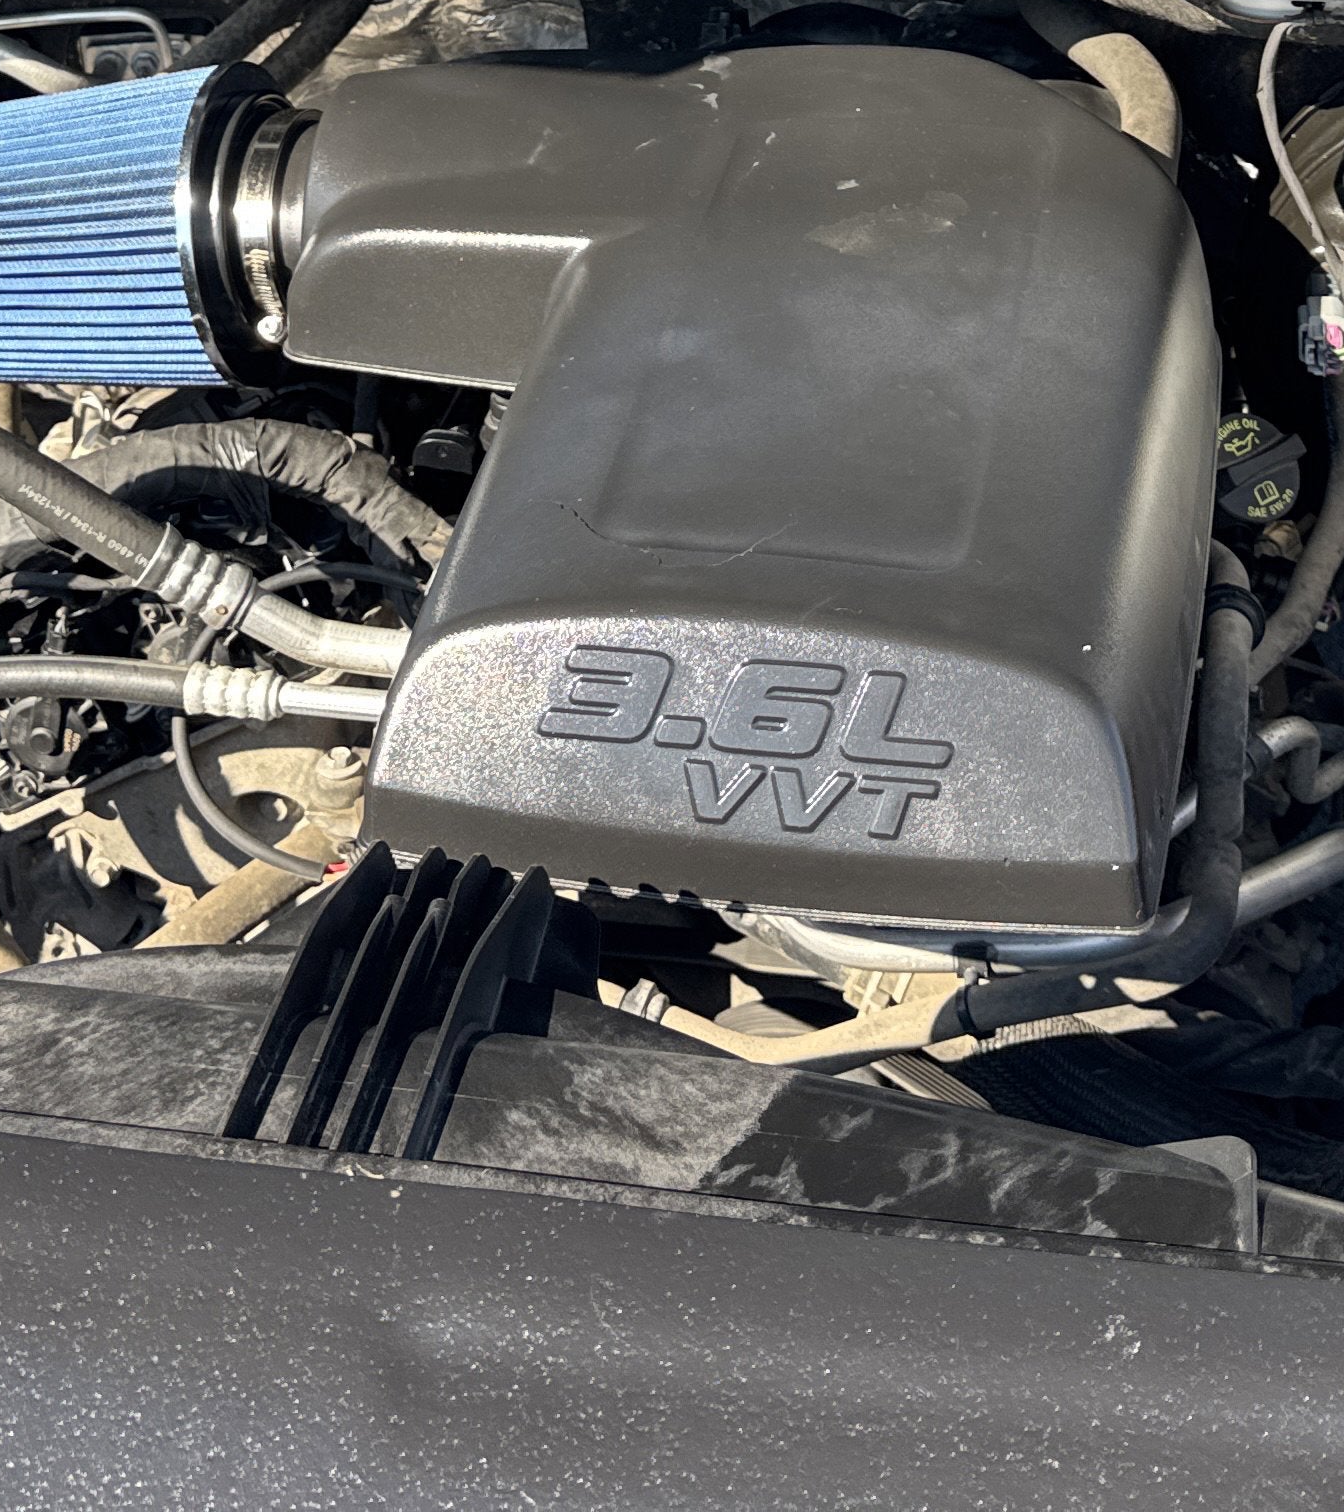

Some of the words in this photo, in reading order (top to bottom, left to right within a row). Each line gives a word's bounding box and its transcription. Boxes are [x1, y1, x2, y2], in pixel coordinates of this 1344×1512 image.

[1217, 419, 1242, 441] GINE
[1241, 418, 1261, 431] OIL
[1247, 505, 1268, 518] SAE
[1269, 488, 1295, 515] 5W-20
[107, 539, 134, 558] 4860
[537, 644, 955, 769] 3.6L
[683, 758, 942, 840] VVT
